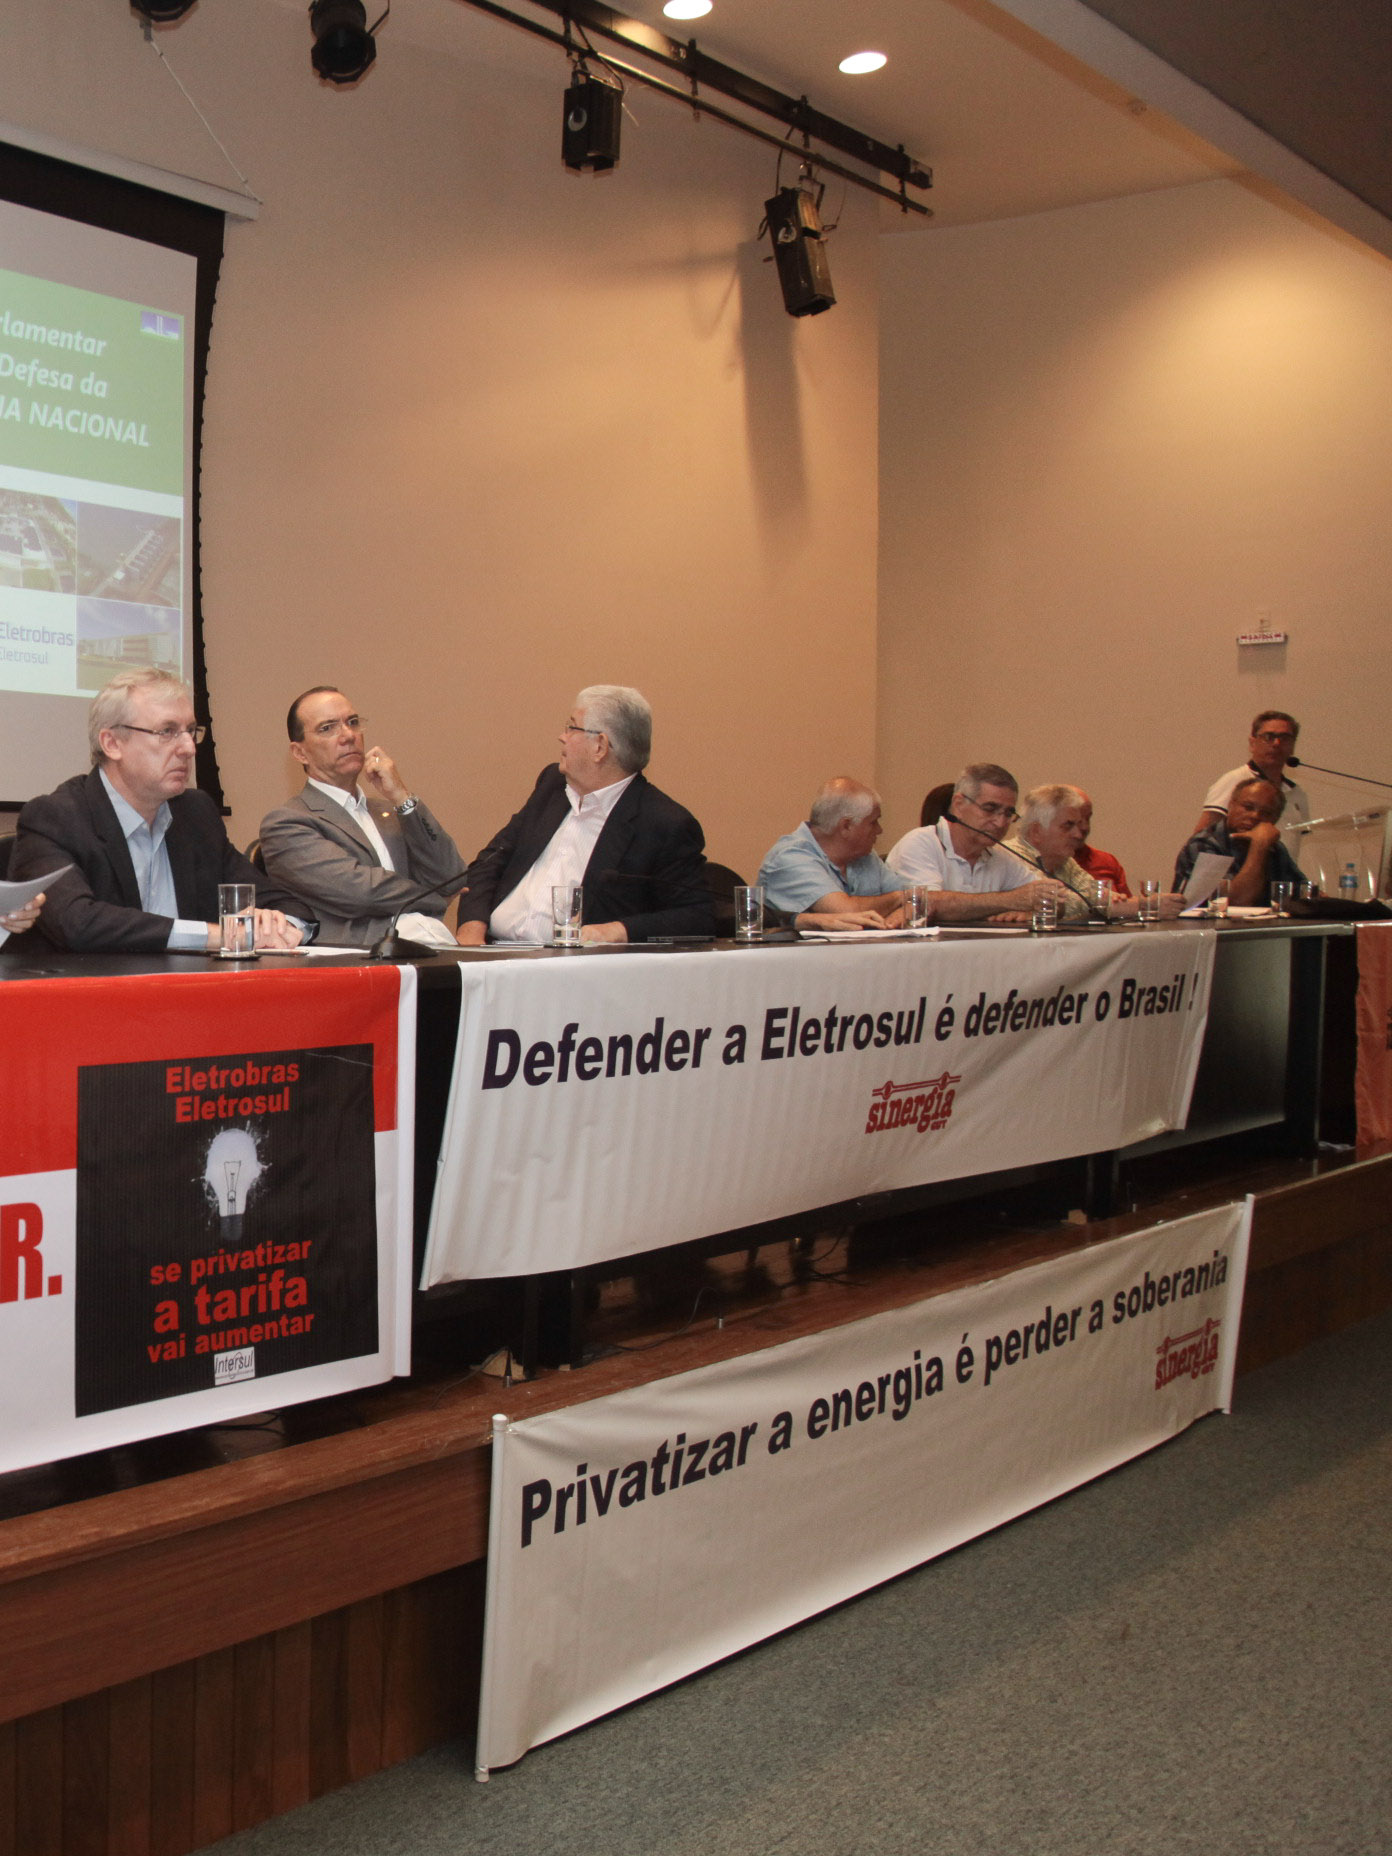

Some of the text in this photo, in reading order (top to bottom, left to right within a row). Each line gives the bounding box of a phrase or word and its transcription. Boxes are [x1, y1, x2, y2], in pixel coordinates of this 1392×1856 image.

[80, 371, 108, 398] da
[28, 402, 151, 448] NACIONAL
[482, 1017, 711, 1090] Defender
[722, 1024, 746, 1066] a
[761, 996, 927, 1061] Eletrosul
[934, 993, 955, 1041] é
[963, 985, 1089, 1038] defender
[1095, 990, 1110, 1022] o
[1118, 973, 1186, 1019] Brasil
[166, 1061, 299, 1093] Eletrobras
[175, 1087, 290, 1123] Eletrosul
[865, 1087, 955, 1134] sinergia
[150, 1239, 312, 1285] se privatizar
[154, 1269, 307, 1333] a tarifa
[147, 1313, 315, 1363] vai aumentar
[1155, 1333, 1219, 1391] sinergia
[520, 1250, 1228, 1549] Privatizar a energia é perder a soberania
